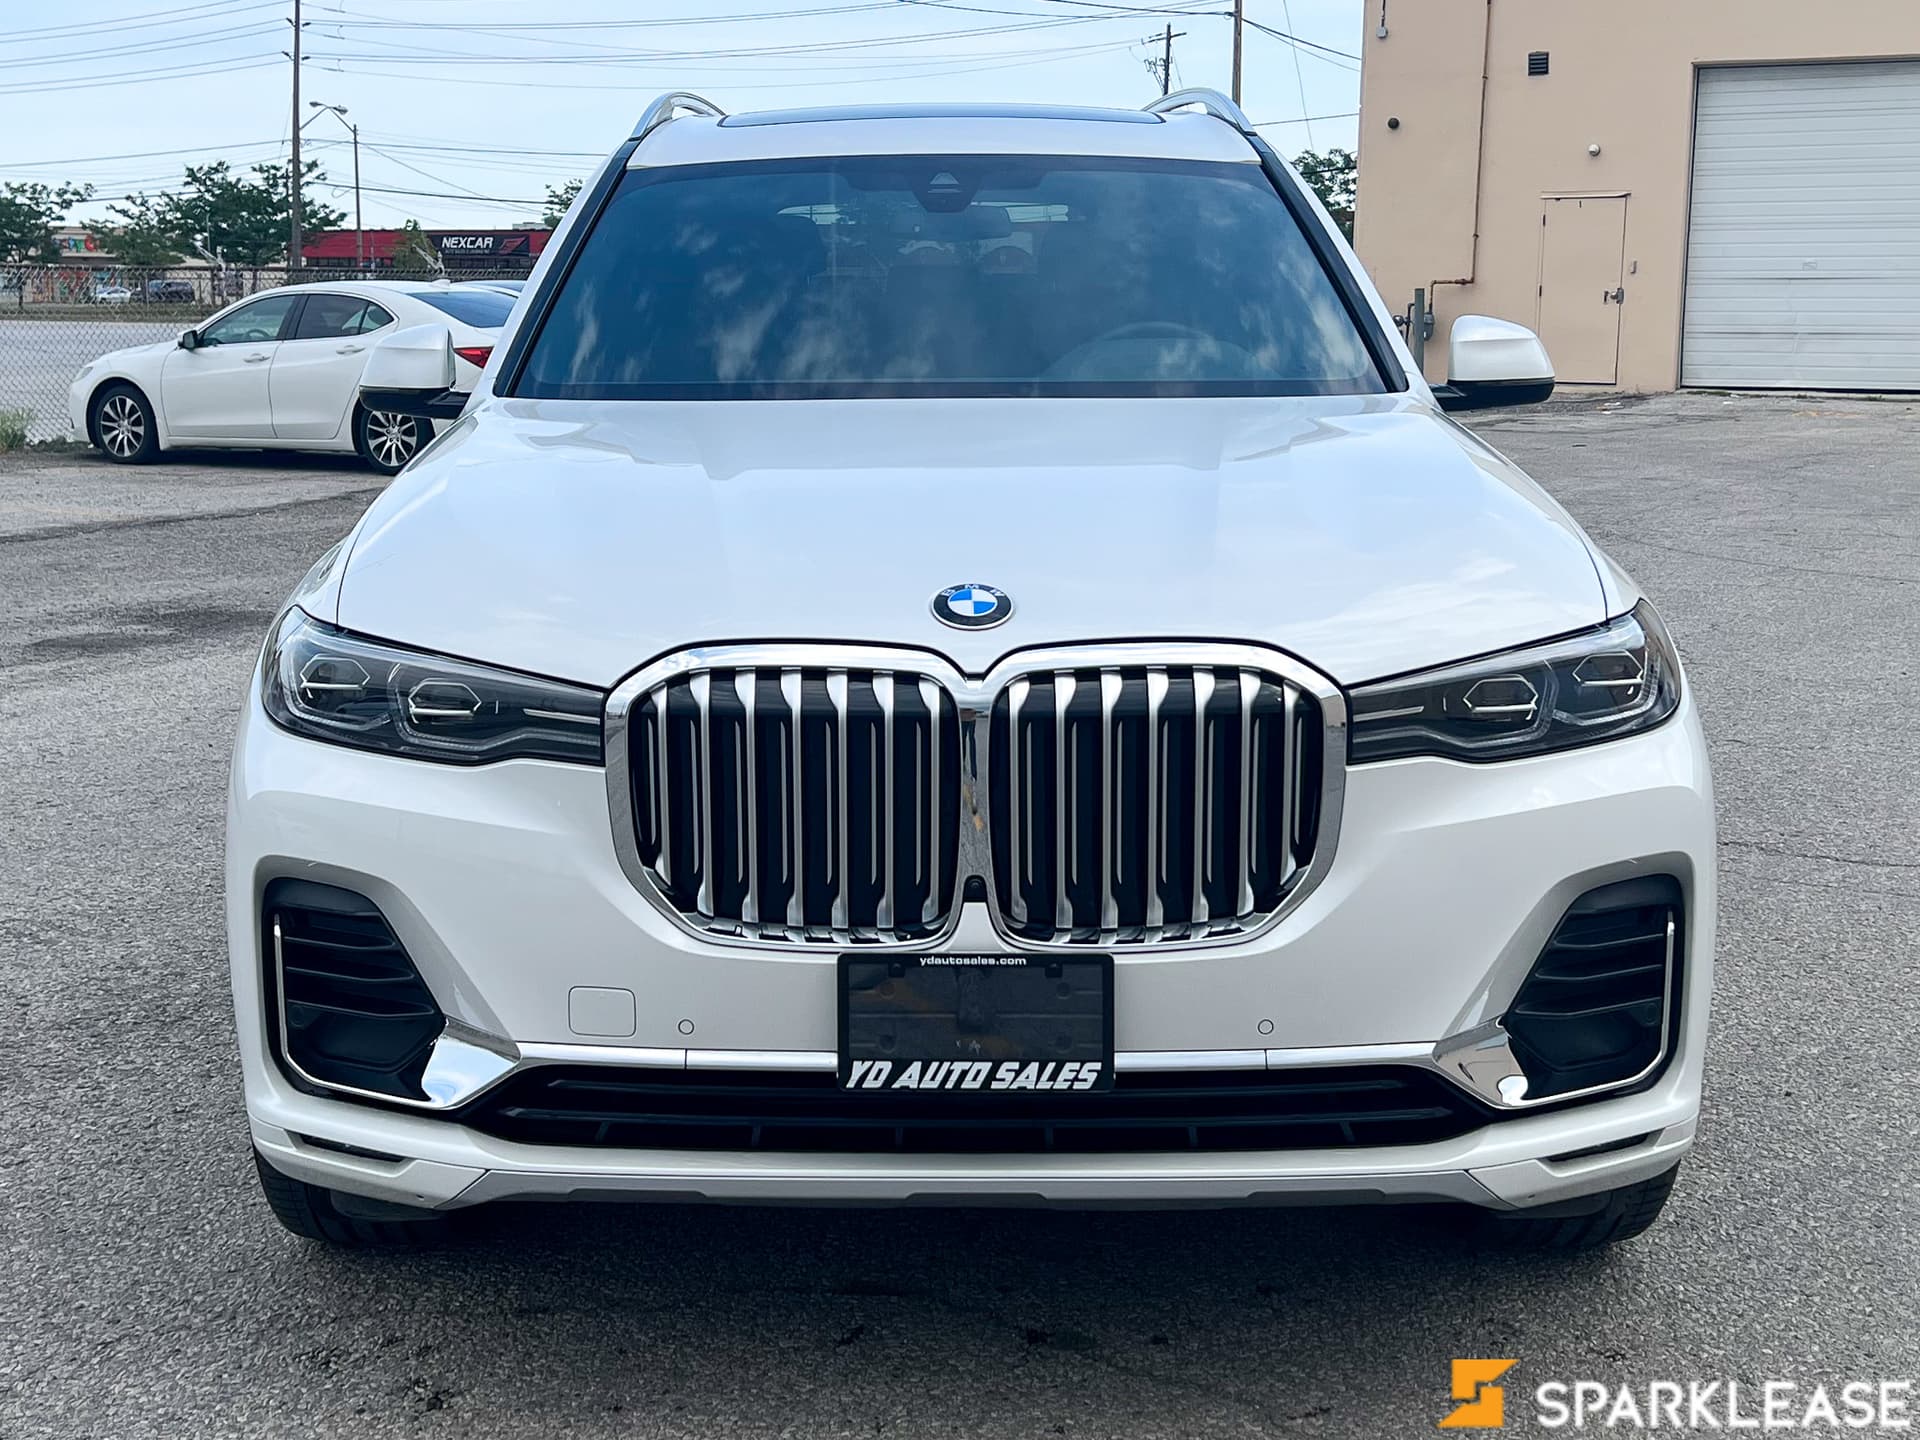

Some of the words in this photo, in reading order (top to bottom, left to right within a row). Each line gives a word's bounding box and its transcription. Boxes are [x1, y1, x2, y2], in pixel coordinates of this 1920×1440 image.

[442, 236, 493, 249] NEXCAR
[919, 955, 1027, 967] ydautosales.com
[846, 1060, 893, 1089] YD
[891, 1060, 992, 1090] AUTO
[990, 1061, 1102, 1090] SALES
